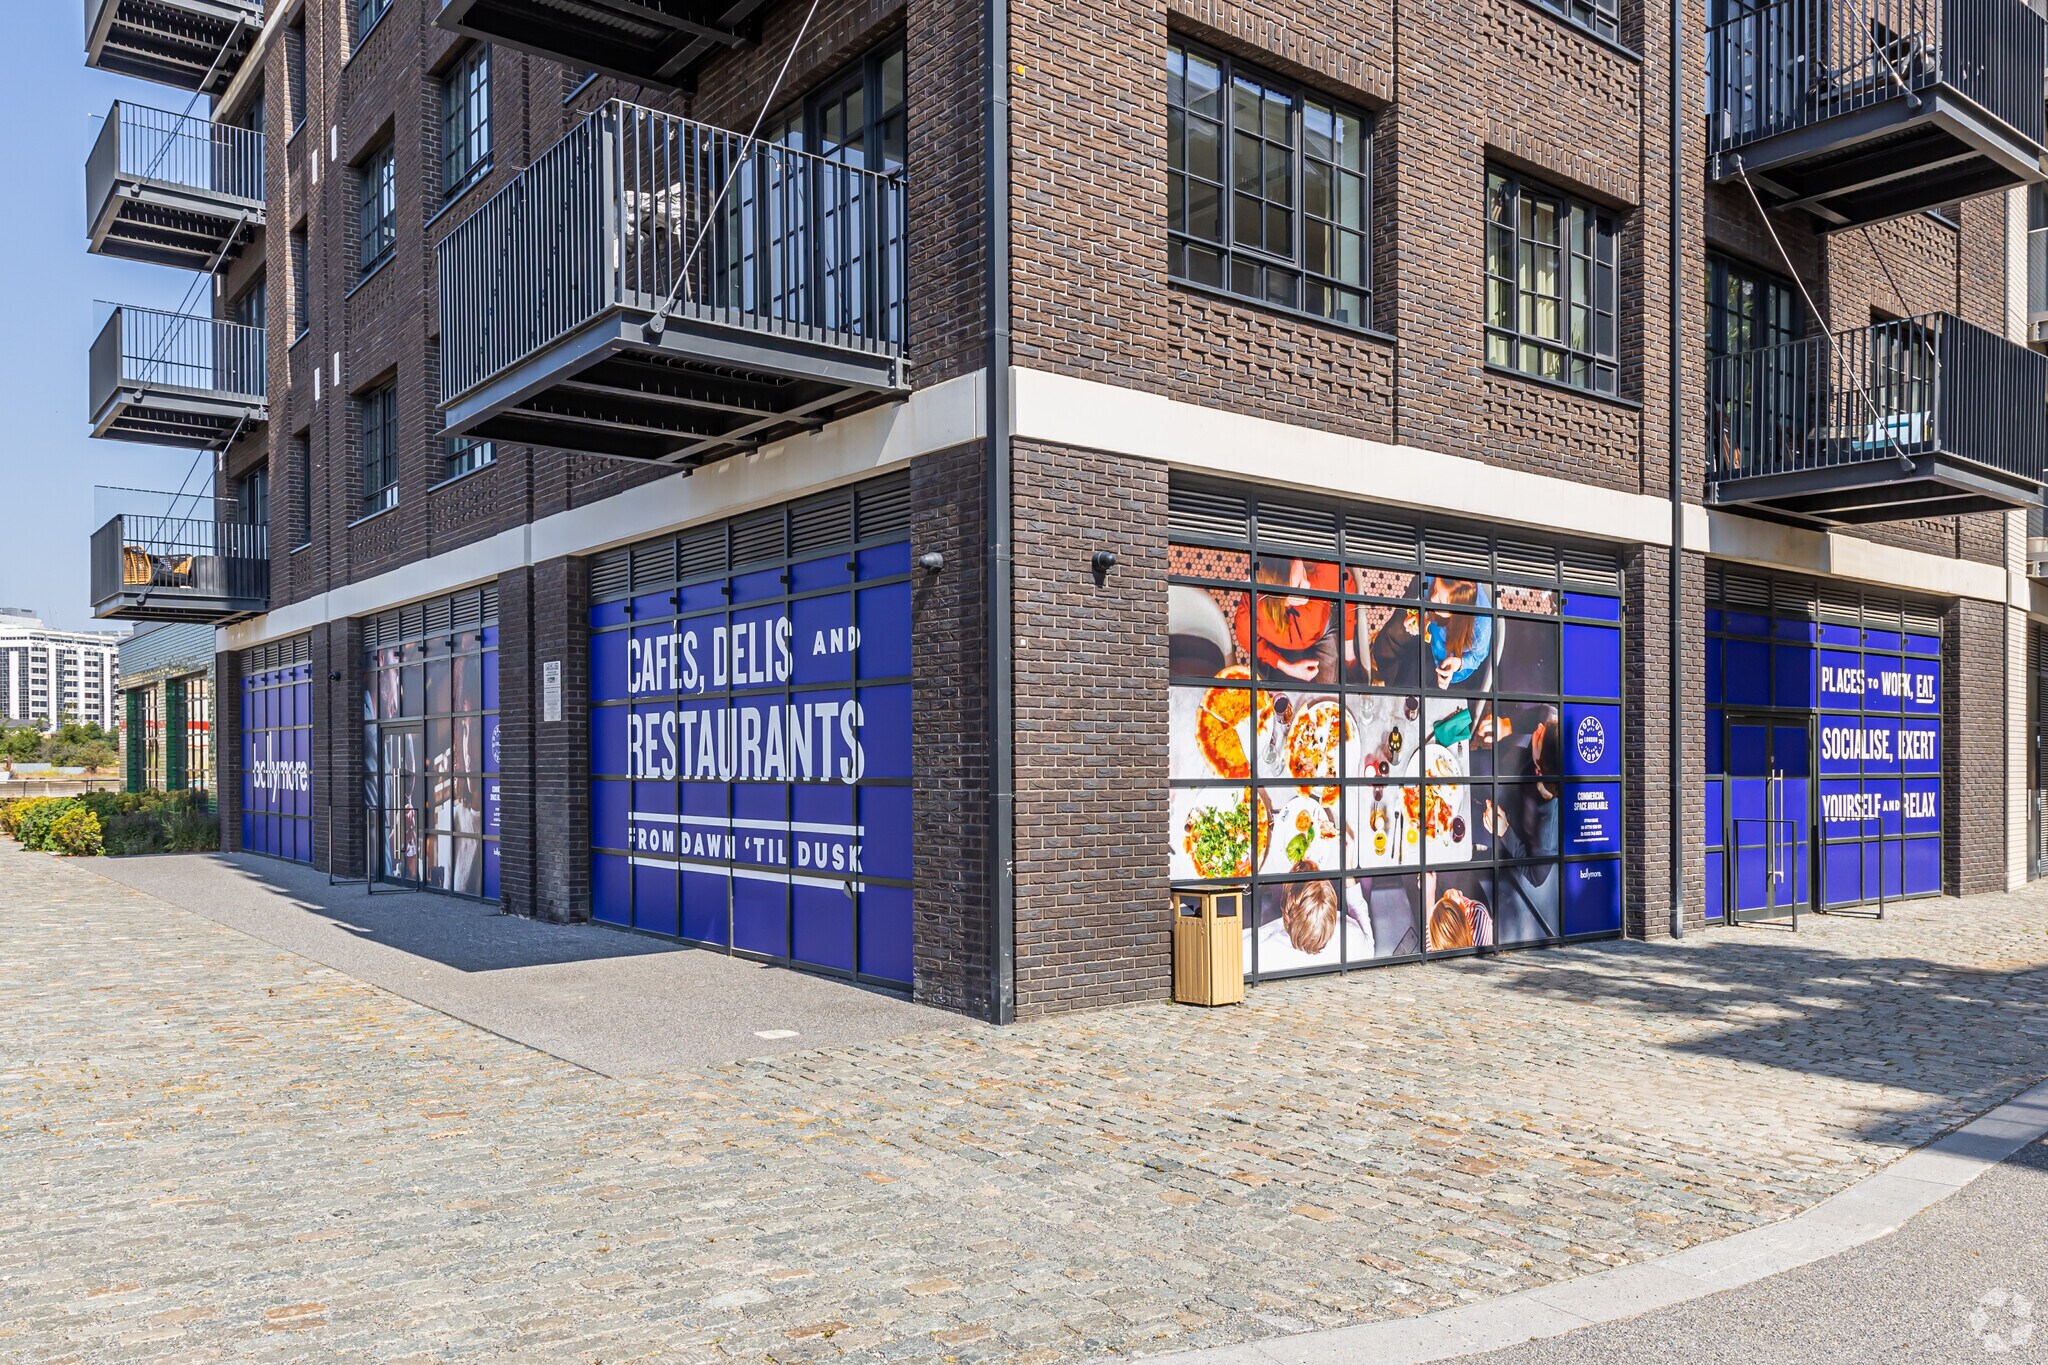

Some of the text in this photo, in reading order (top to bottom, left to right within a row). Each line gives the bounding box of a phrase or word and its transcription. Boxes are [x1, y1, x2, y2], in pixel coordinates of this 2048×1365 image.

[713, 616, 793, 686] DELIS
[813, 626, 861, 655] AND
[1821, 666, 1935, 703] PLACES TO WORK, EAT,
[626, 699, 865, 784] RESTAURANTS
[1582, 750, 1600, 760] HOPE
[1822, 727, 1935, 763] SOCIALISE, EXERT
[1574, 801, 1609, 810] SPACE AVAILABLE
[1578, 792, 1605, 800] COMMERCIAL
[1822, 792, 1935, 822] YOURSELF AND RELAX
[628, 827, 674, 852] FROM
[681, 832, 736, 860] DAWN
[798, 840, 863, 872] DUSK
